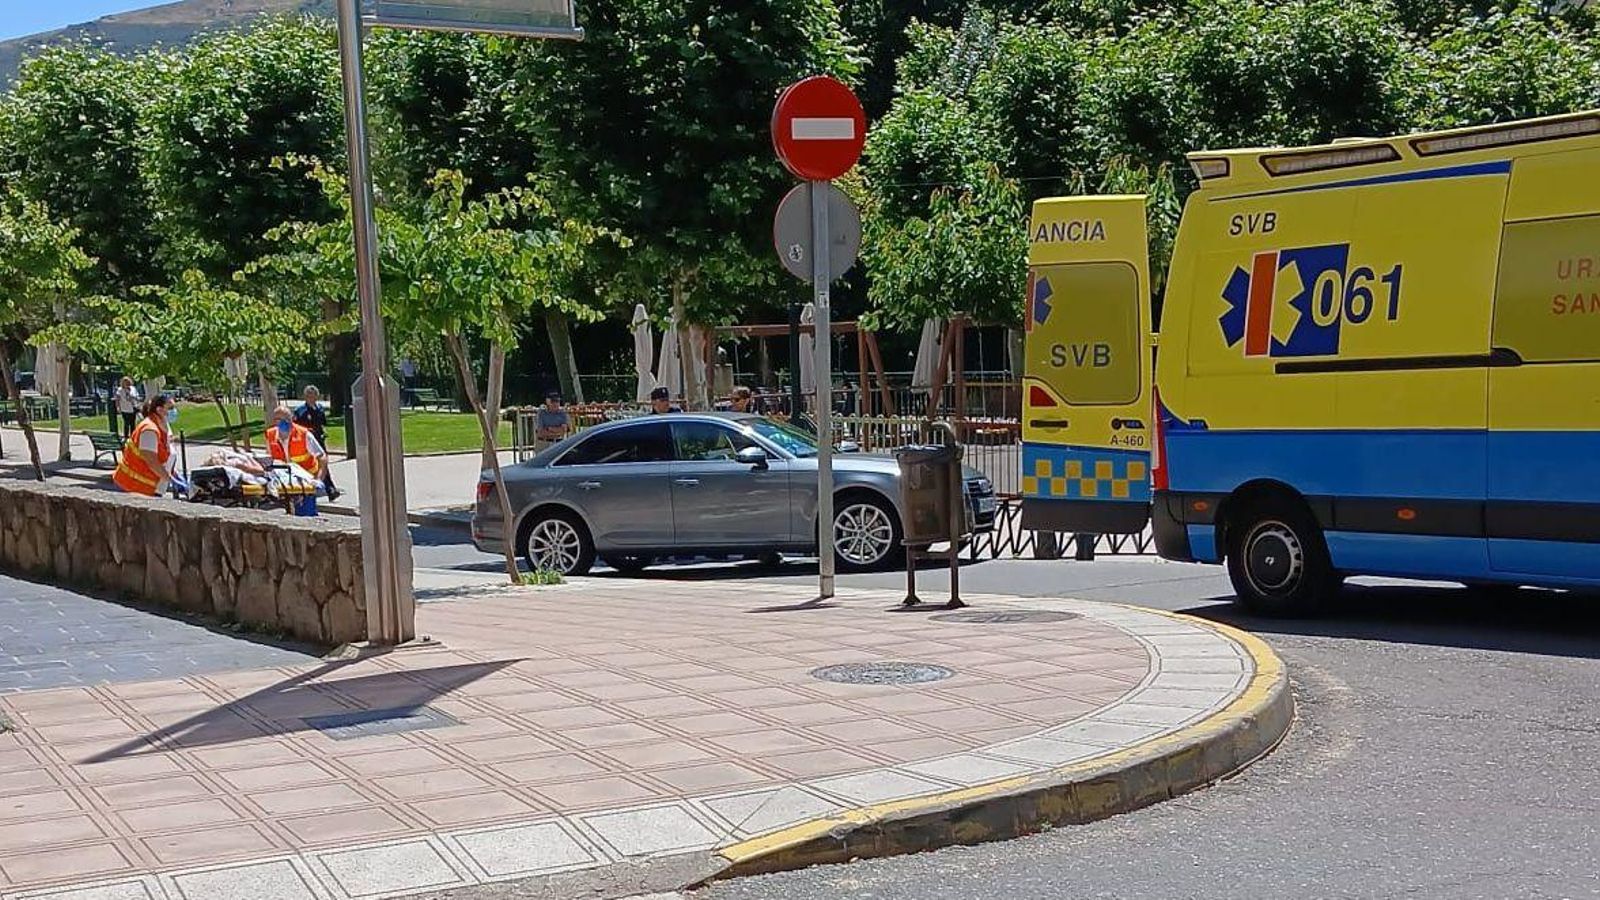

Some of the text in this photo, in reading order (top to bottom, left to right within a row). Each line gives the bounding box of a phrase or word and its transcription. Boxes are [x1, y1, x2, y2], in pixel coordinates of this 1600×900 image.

[1031, 219, 1106, 243] ANCIA
[1229, 211, 1277, 236] SVB
[1557, 258, 1600, 280] UR
[1311, 263, 1404, 327] 061
[1050, 343, 1112, 368] SVB
[1110, 434, 1144, 447] A-460
